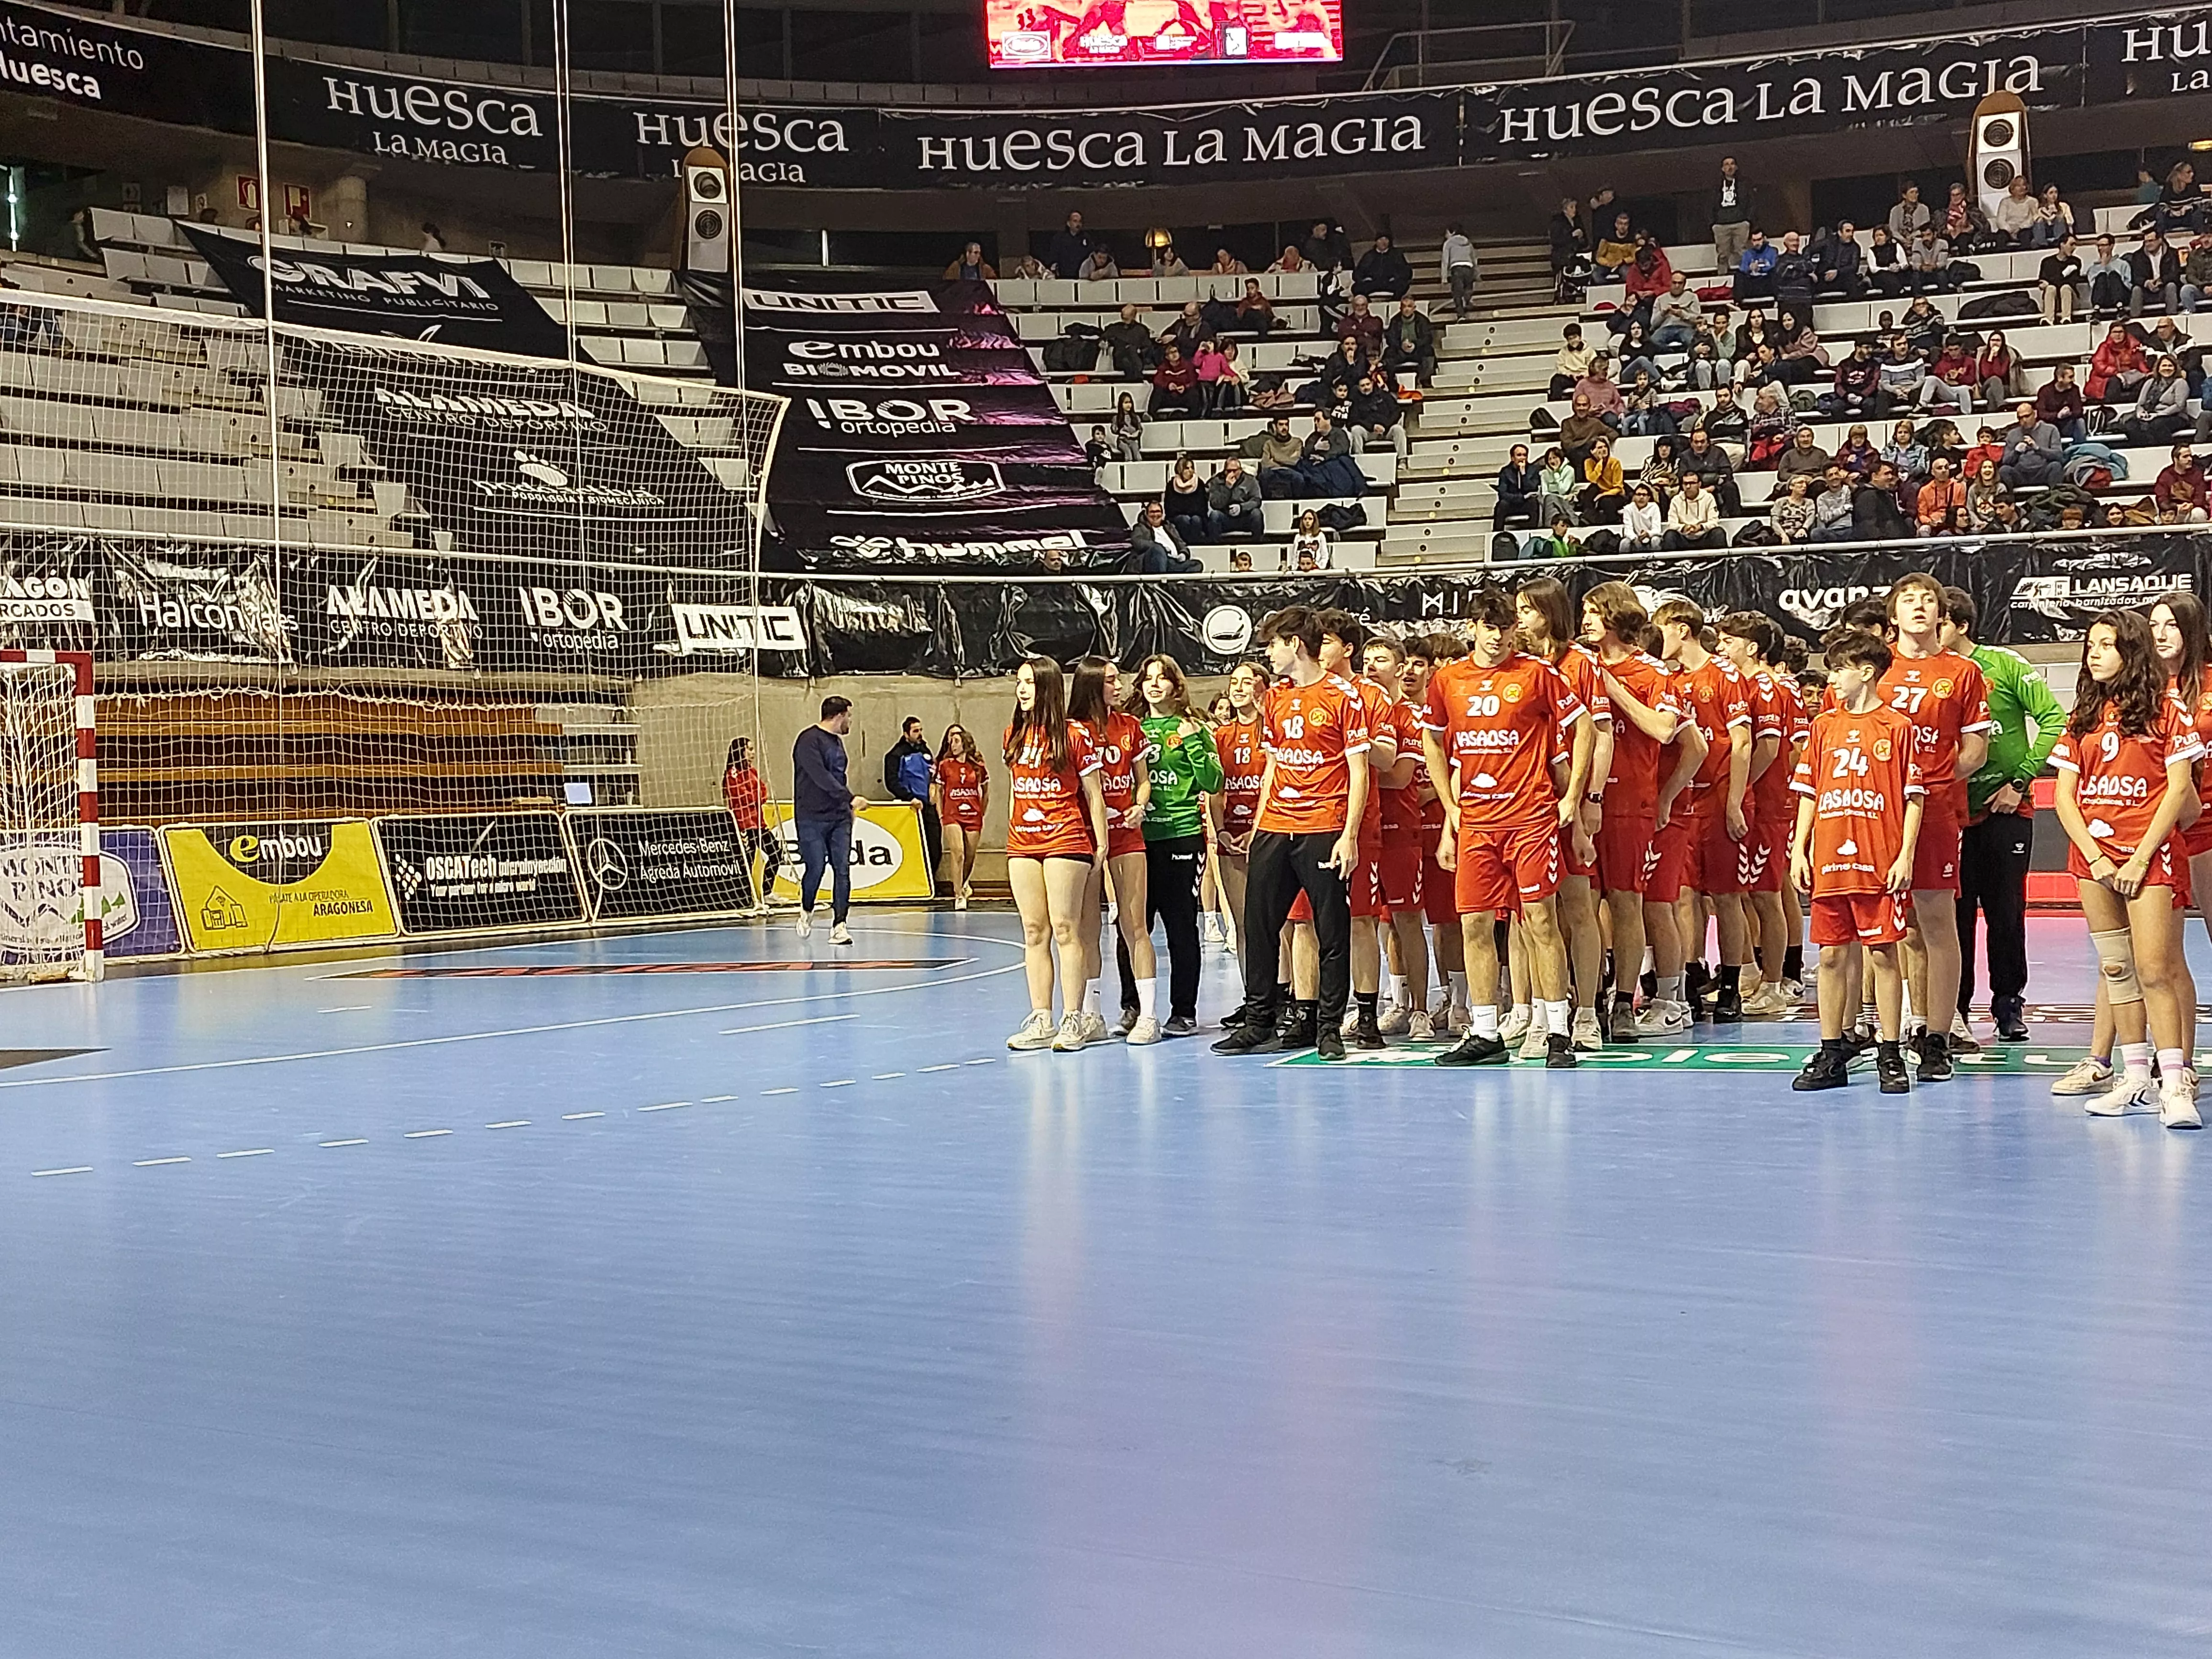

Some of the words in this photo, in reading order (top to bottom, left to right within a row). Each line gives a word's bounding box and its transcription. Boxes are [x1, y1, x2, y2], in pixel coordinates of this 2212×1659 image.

[754, 294, 921, 310] UNITIC
[788, 339, 940, 359] embou
[841, 420, 956, 438] ortopedia
[885, 462, 962, 474] MONTE
[897, 472, 965, 485] PINOS
[2075, 574, 2193, 594] LANSAQUE
[683, 612, 794, 641] UNITIC
[543, 632, 619, 651] ortopedia
[1467, 695, 1500, 717] 20
[1891, 686, 1929, 713] 27
[1234, 747, 1251, 764] 18
[2101, 731, 2120, 762] 9
[1833, 747, 1869, 778] 24
[230, 833, 322, 862] embou
[313, 900, 374, 917] ARAGONESA
